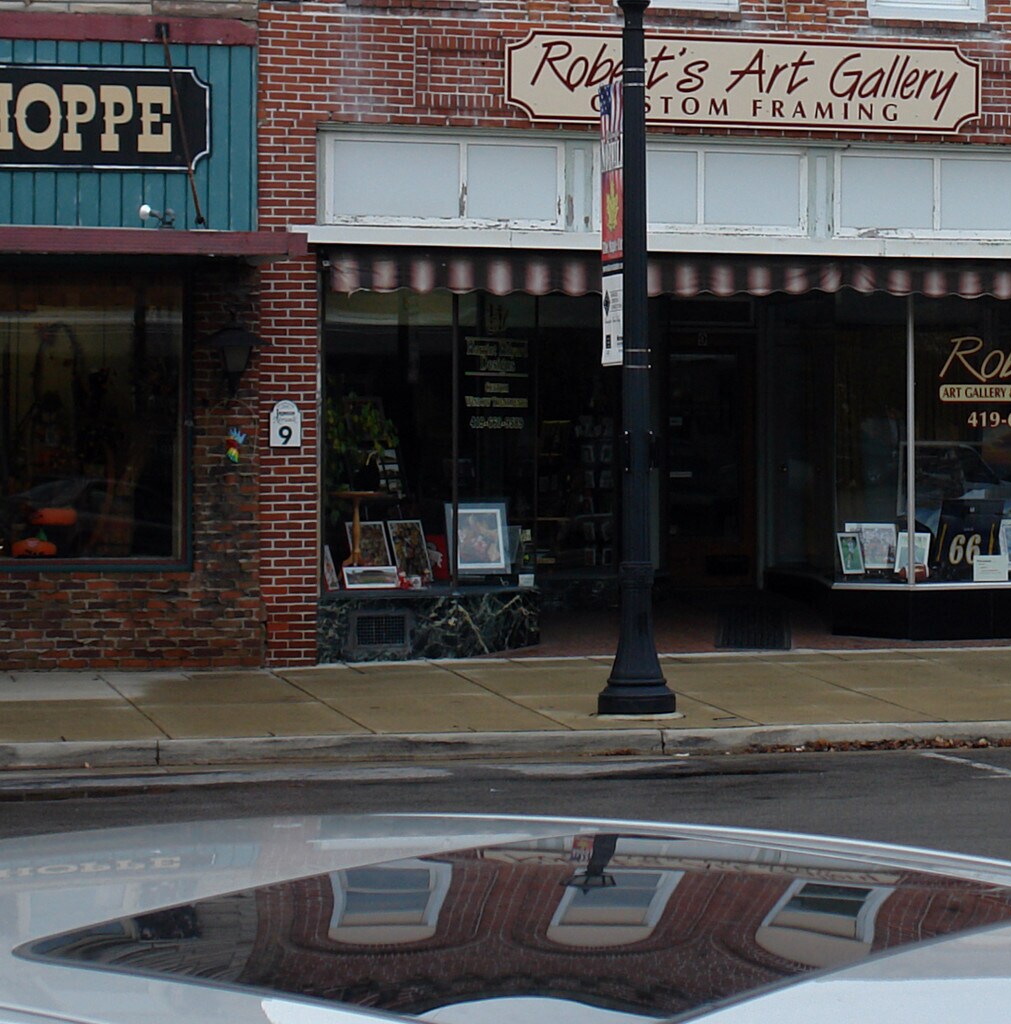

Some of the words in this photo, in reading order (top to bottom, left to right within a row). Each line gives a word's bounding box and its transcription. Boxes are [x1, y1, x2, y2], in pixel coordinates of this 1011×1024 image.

[530, 40, 709, 94] Robt's
[726, 48, 814, 95] Art
[829, 52, 959, 121] Gallery
[590, 94, 729, 117] CSTOM
[752, 99, 898, 121] FRAMING
[942, 386, 960, 399] ART
[964, 386, 1007, 399] GALLERY
[278, 425, 293, 445] 9
[949, 533, 982, 565] 66
